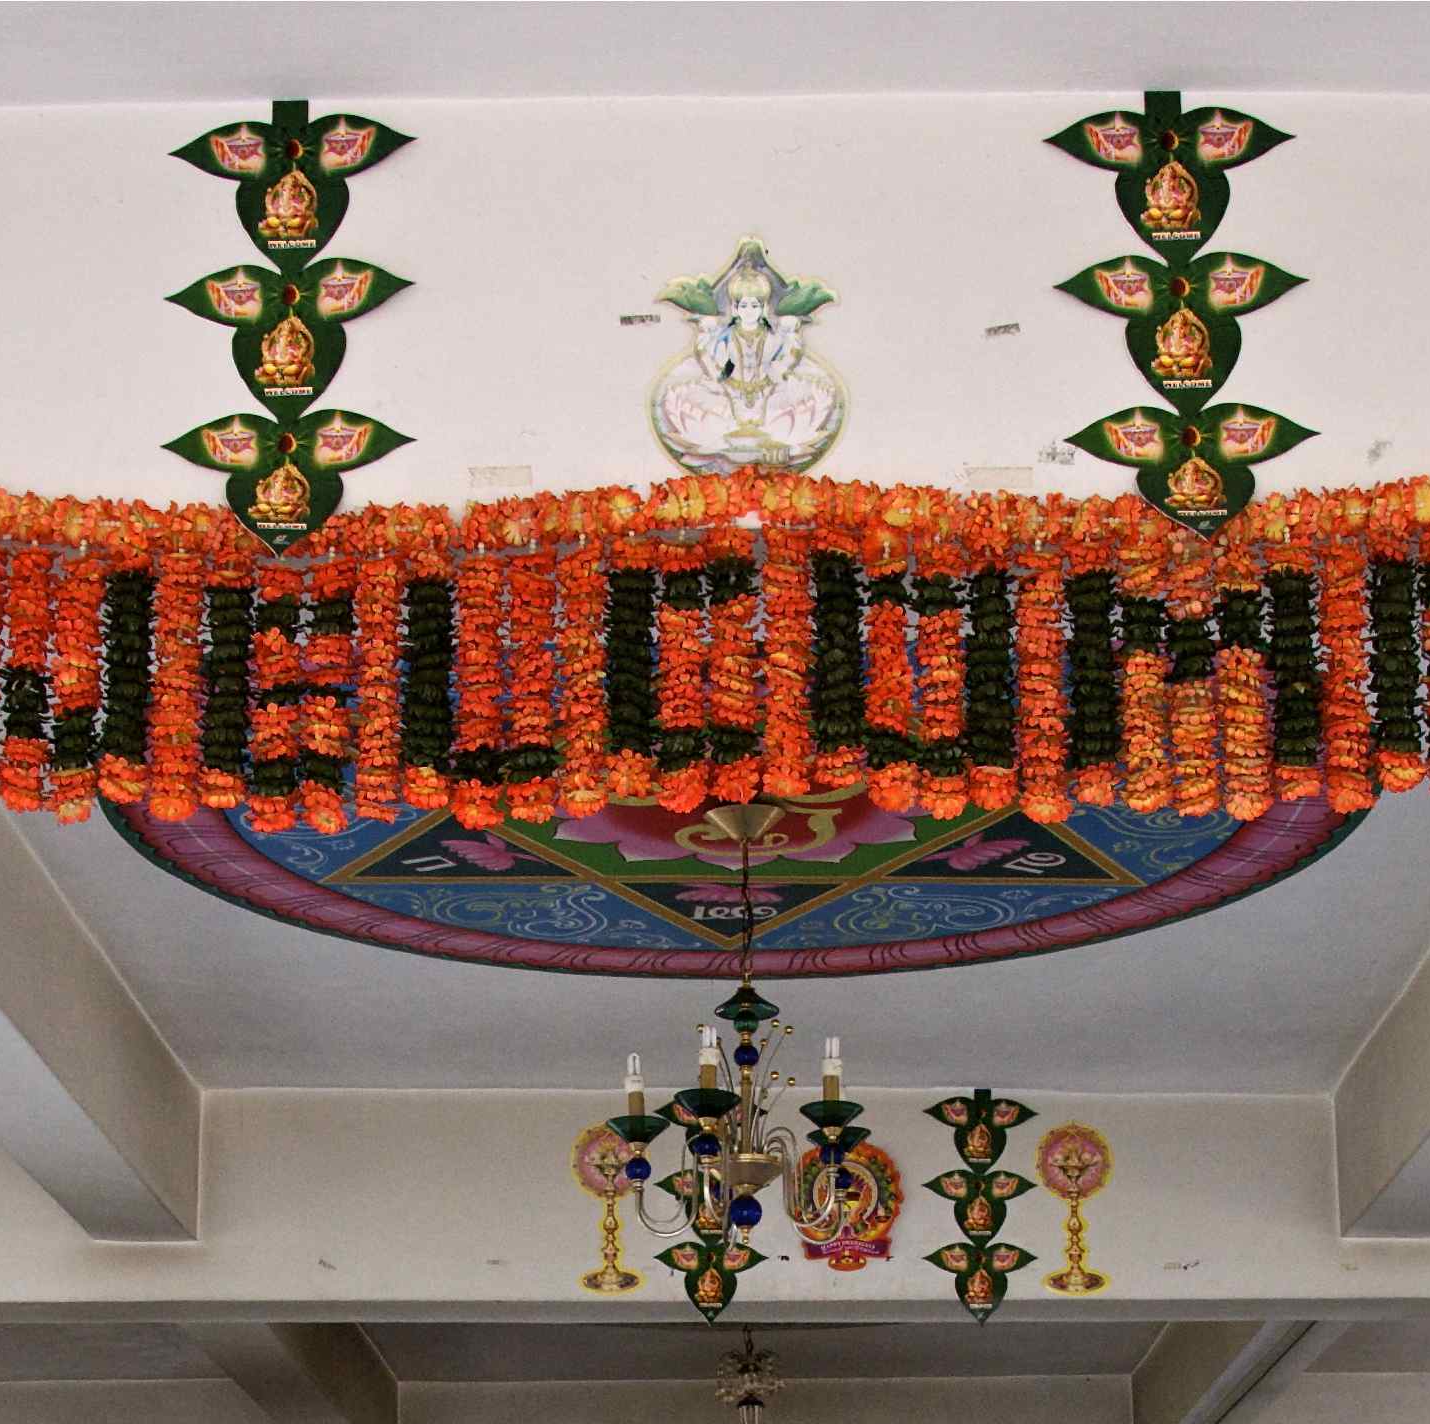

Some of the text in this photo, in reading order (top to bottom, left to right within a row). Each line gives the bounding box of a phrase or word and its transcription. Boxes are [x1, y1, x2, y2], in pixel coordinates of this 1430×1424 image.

[1152, 232, 1201, 240] WELCOME
[268, 240, 316, 249] WELCOME
[1163, 380, 1212, 388] WELCOME
[264, 387, 313, 396] WELCOME
